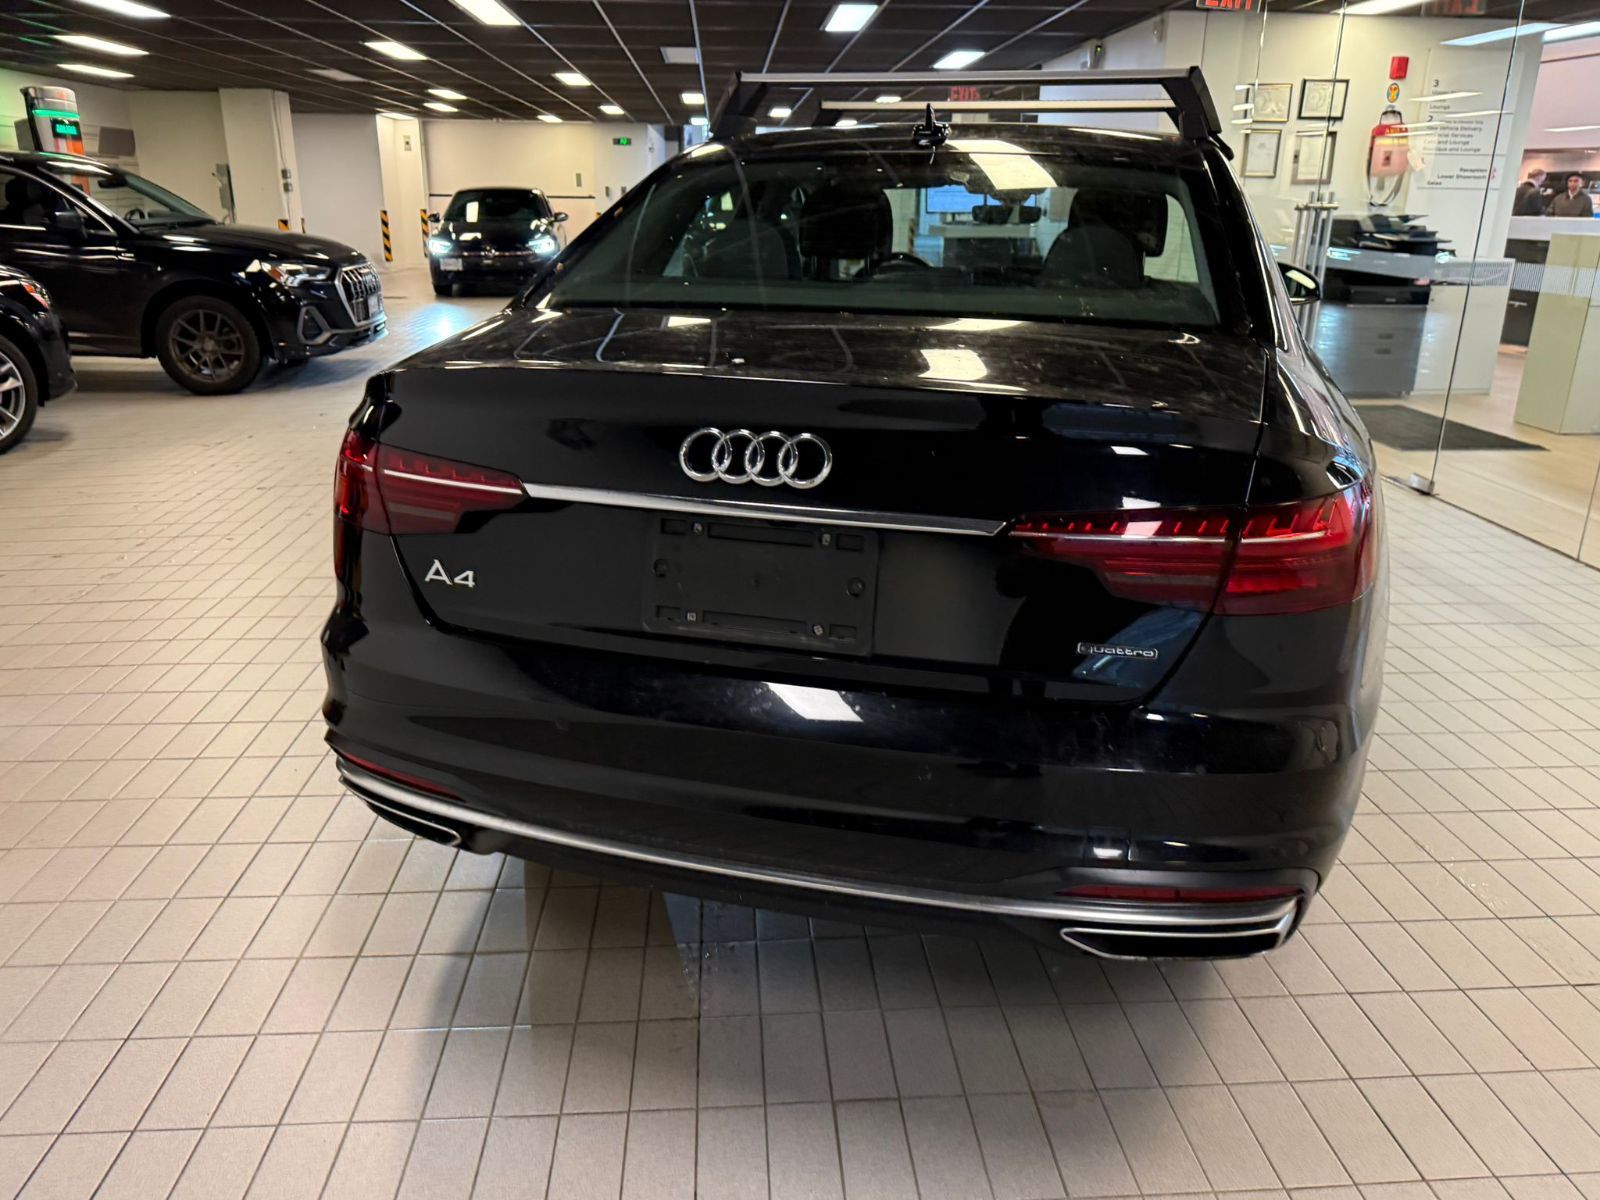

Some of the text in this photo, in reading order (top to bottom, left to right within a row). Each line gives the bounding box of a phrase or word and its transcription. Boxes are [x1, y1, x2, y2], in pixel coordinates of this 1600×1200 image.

[1433, 79, 1440, 88] 3
[424, 559, 475, 588] A4
[1079, 642, 1156, 659] quattro
